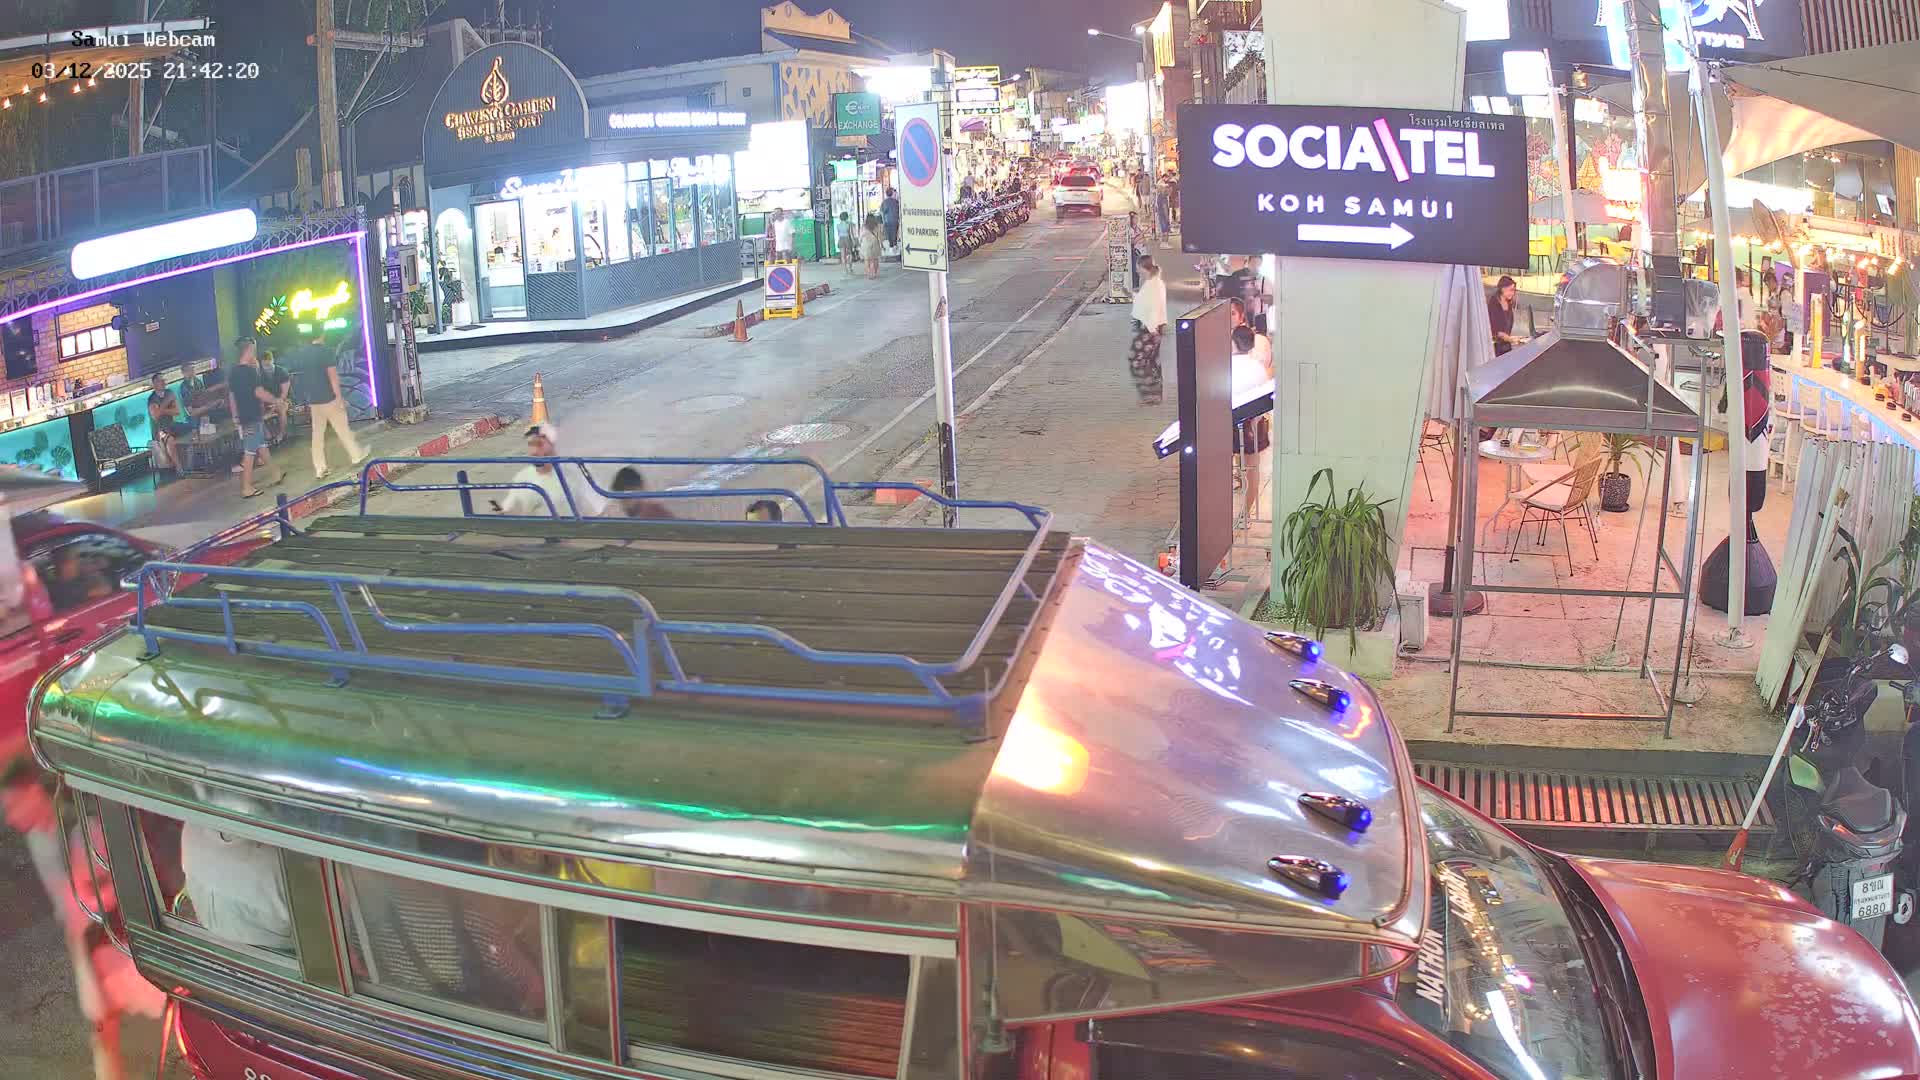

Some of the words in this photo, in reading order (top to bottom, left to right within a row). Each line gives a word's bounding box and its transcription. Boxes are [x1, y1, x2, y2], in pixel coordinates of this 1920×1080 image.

[838, 119, 879, 129] EXCHANGE
[1257, 193, 1325, 214] KOH
[1344, 195, 1454, 220] SAMUI
[907, 227, 915, 236] NO
[915, 227, 939, 237] PARKING
[1858, 902, 1886, 917] 6880
[1416, 928, 1444, 1006] NATHON
